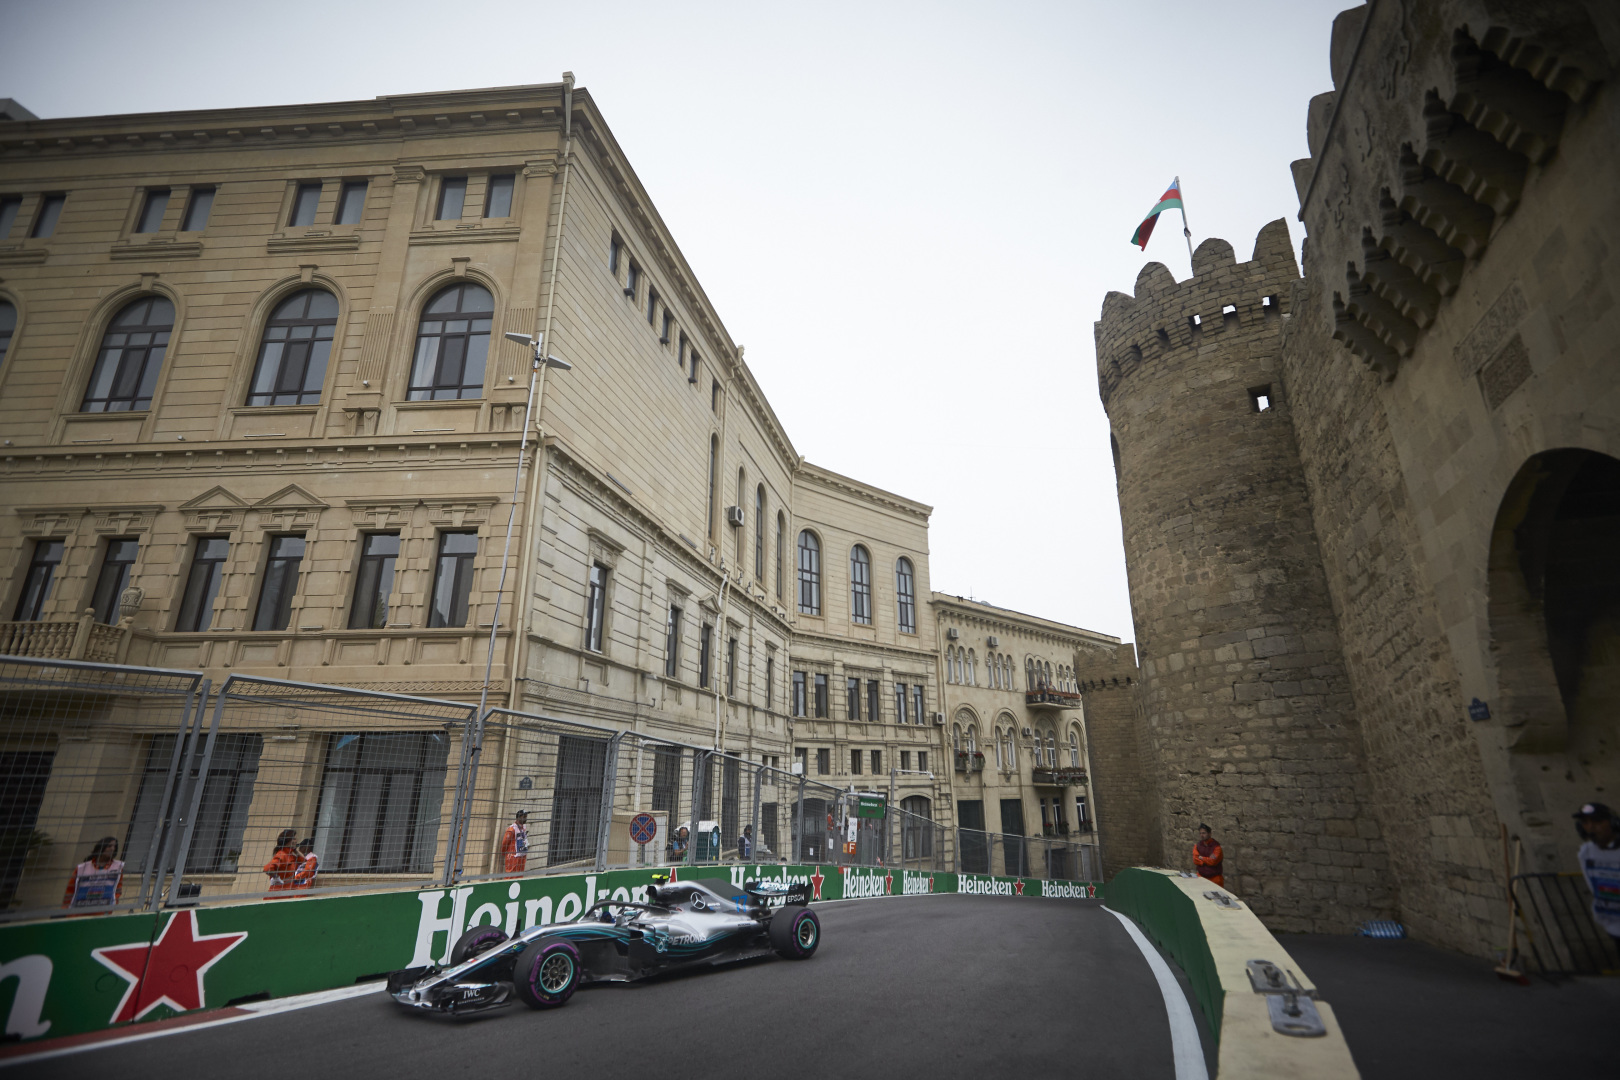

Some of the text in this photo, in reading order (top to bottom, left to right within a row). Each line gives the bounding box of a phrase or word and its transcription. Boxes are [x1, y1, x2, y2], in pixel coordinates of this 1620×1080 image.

[842, 867, 885, 899] Heineken
[902, 870, 929, 895] Heineken
[957, 874, 1013, 896] Heineken
[1041, 880, 1087, 899] Heineken
[732, 895, 748, 913] 77
[787, 894, 805, 903] EPSON
[463, 988, 481, 999] IWC
